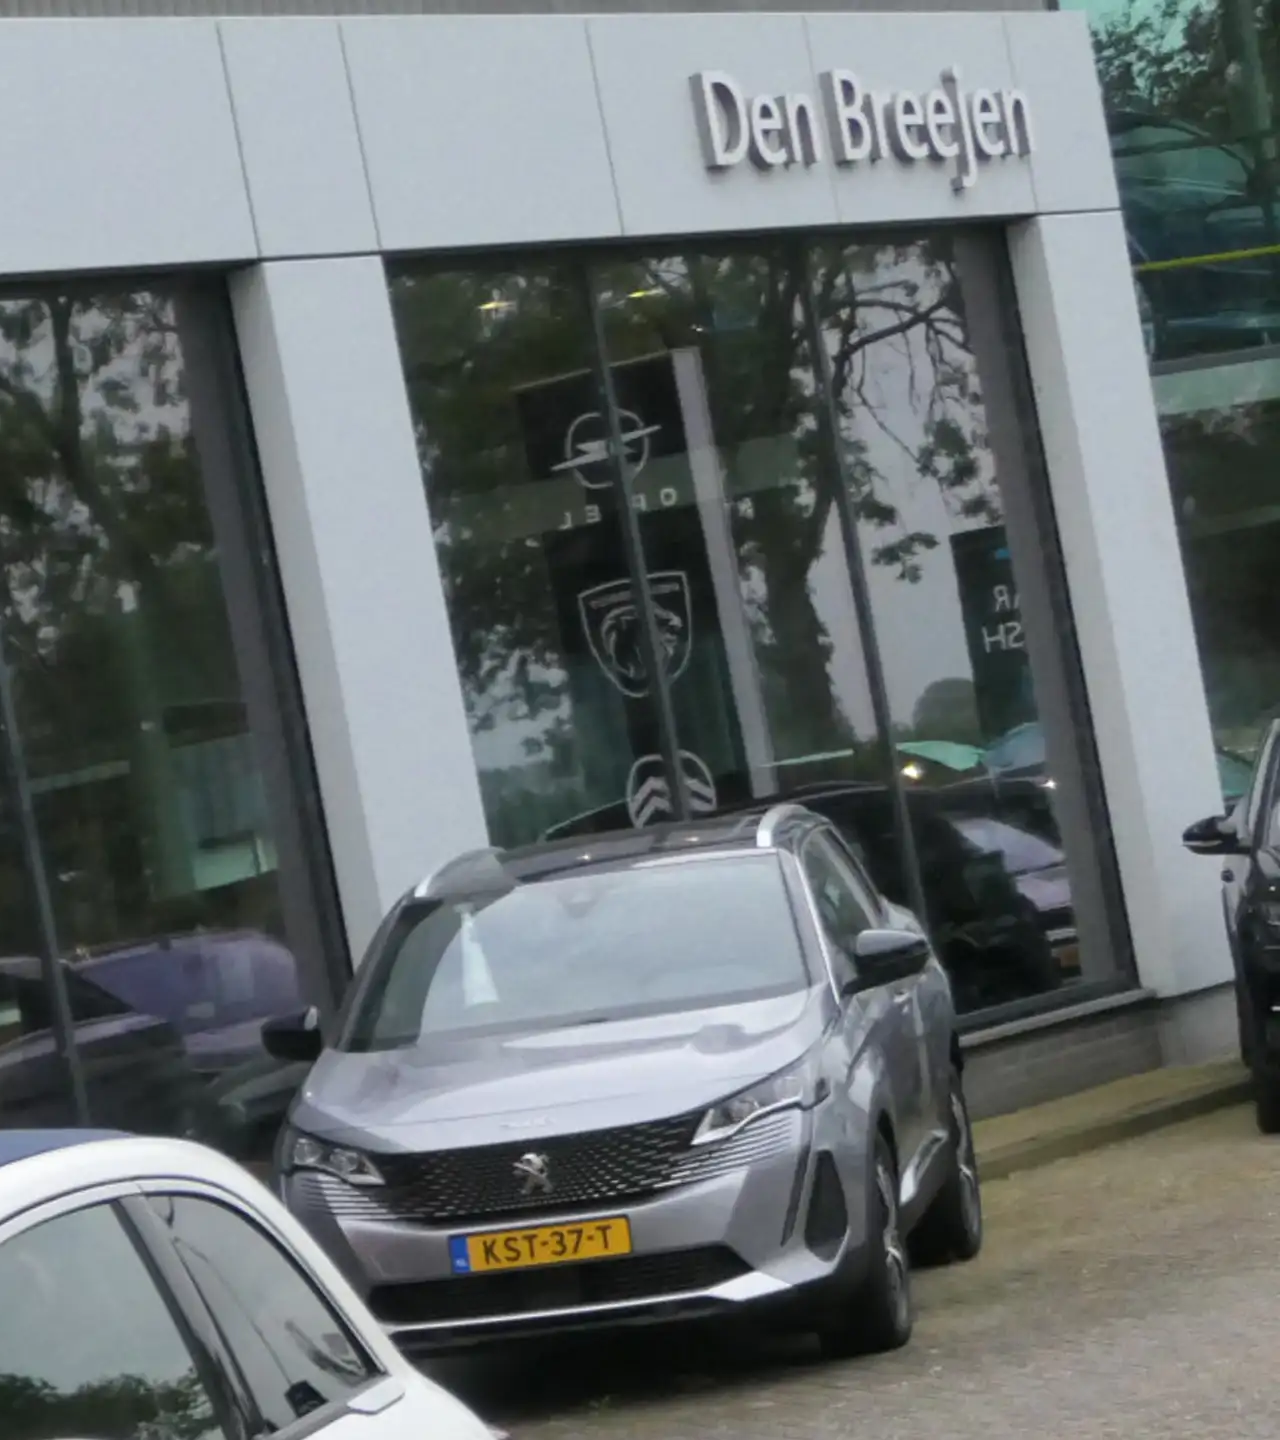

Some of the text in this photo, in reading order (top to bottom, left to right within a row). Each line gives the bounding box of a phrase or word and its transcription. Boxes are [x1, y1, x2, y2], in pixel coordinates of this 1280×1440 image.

[689, 62, 1037, 194] Den Breejen
[482, 1224, 612, 1266] KST-37-T
